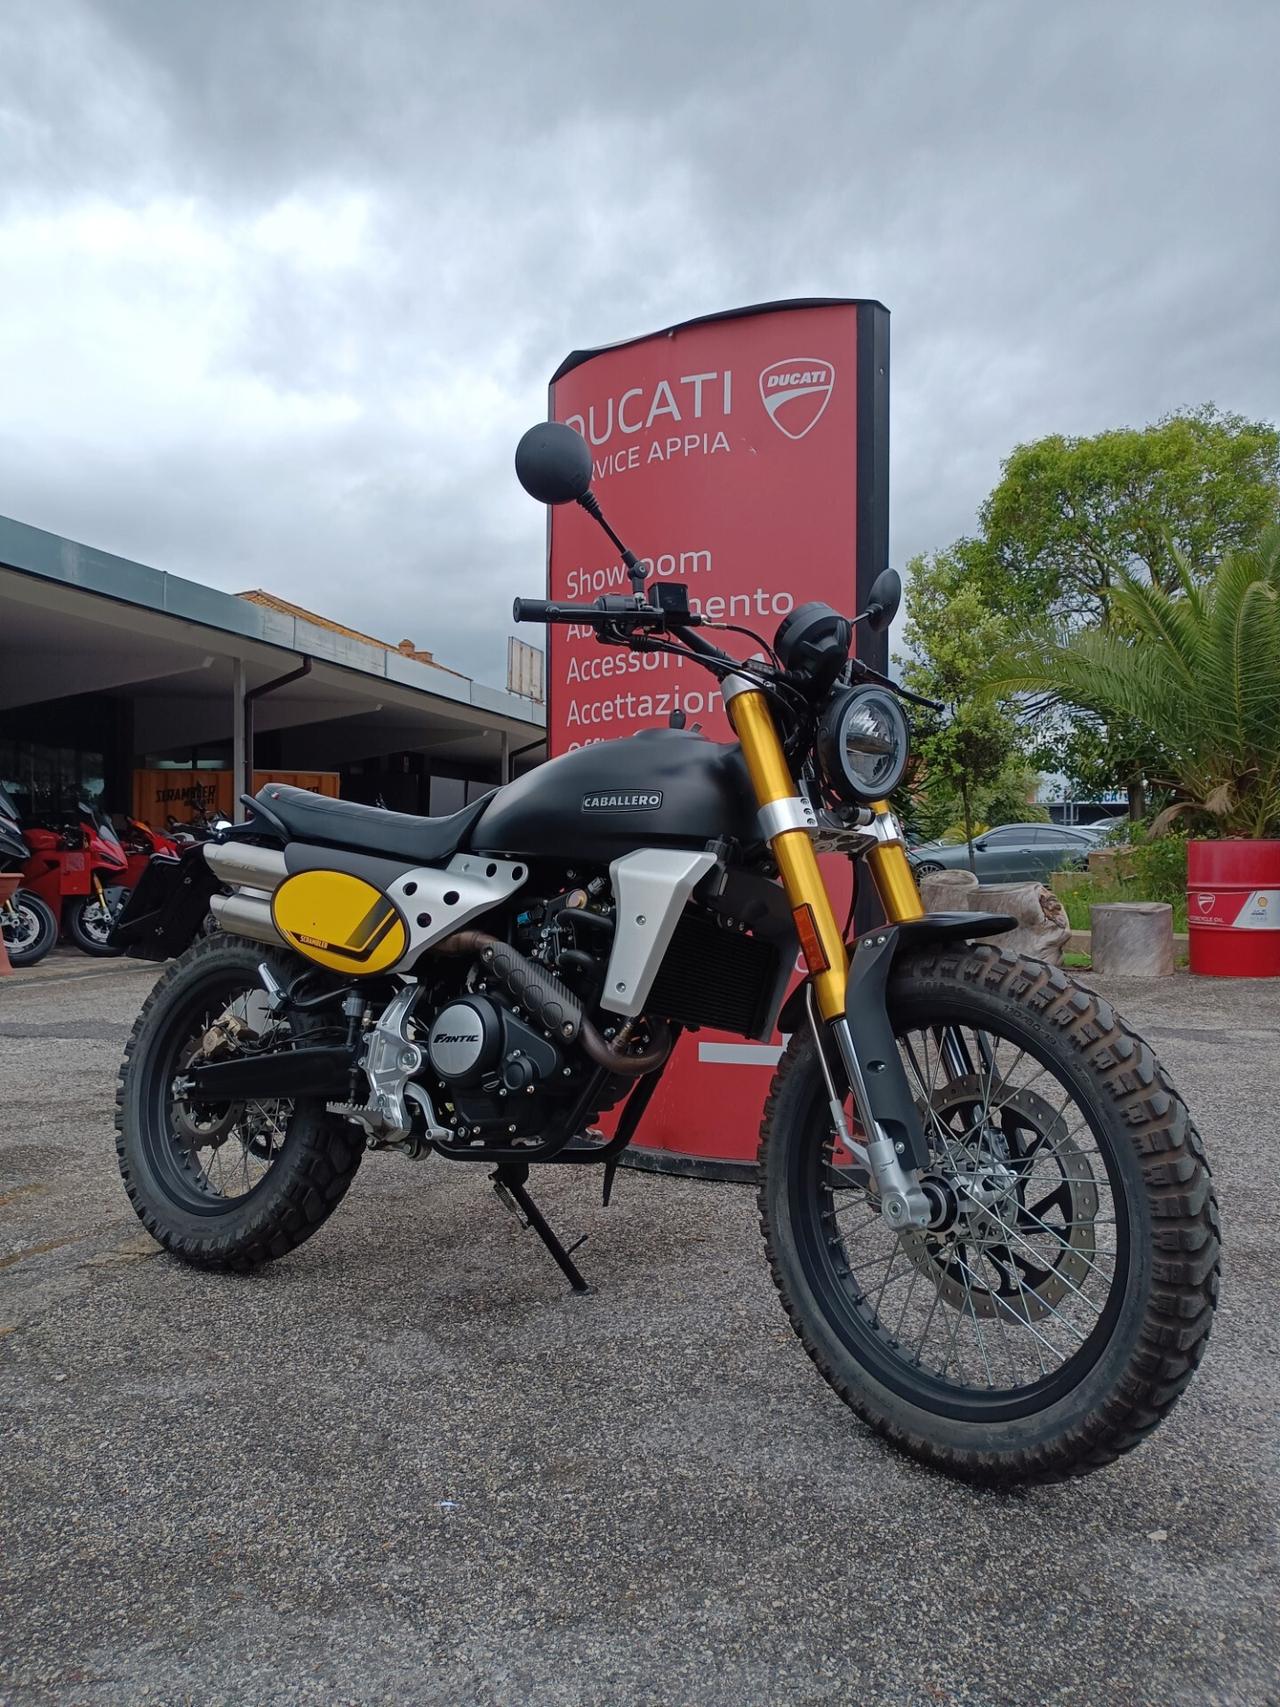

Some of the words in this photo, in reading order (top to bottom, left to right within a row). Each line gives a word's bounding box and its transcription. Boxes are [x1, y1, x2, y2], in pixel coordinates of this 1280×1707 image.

[767, 370, 826, 388] DUCATI
[647, 431, 731, 464] APPIA
[566, 549, 712, 599] Showoom
[583, 795, 660, 809] CABALLERO
[433, 1032, 479, 1044] FANTIC
